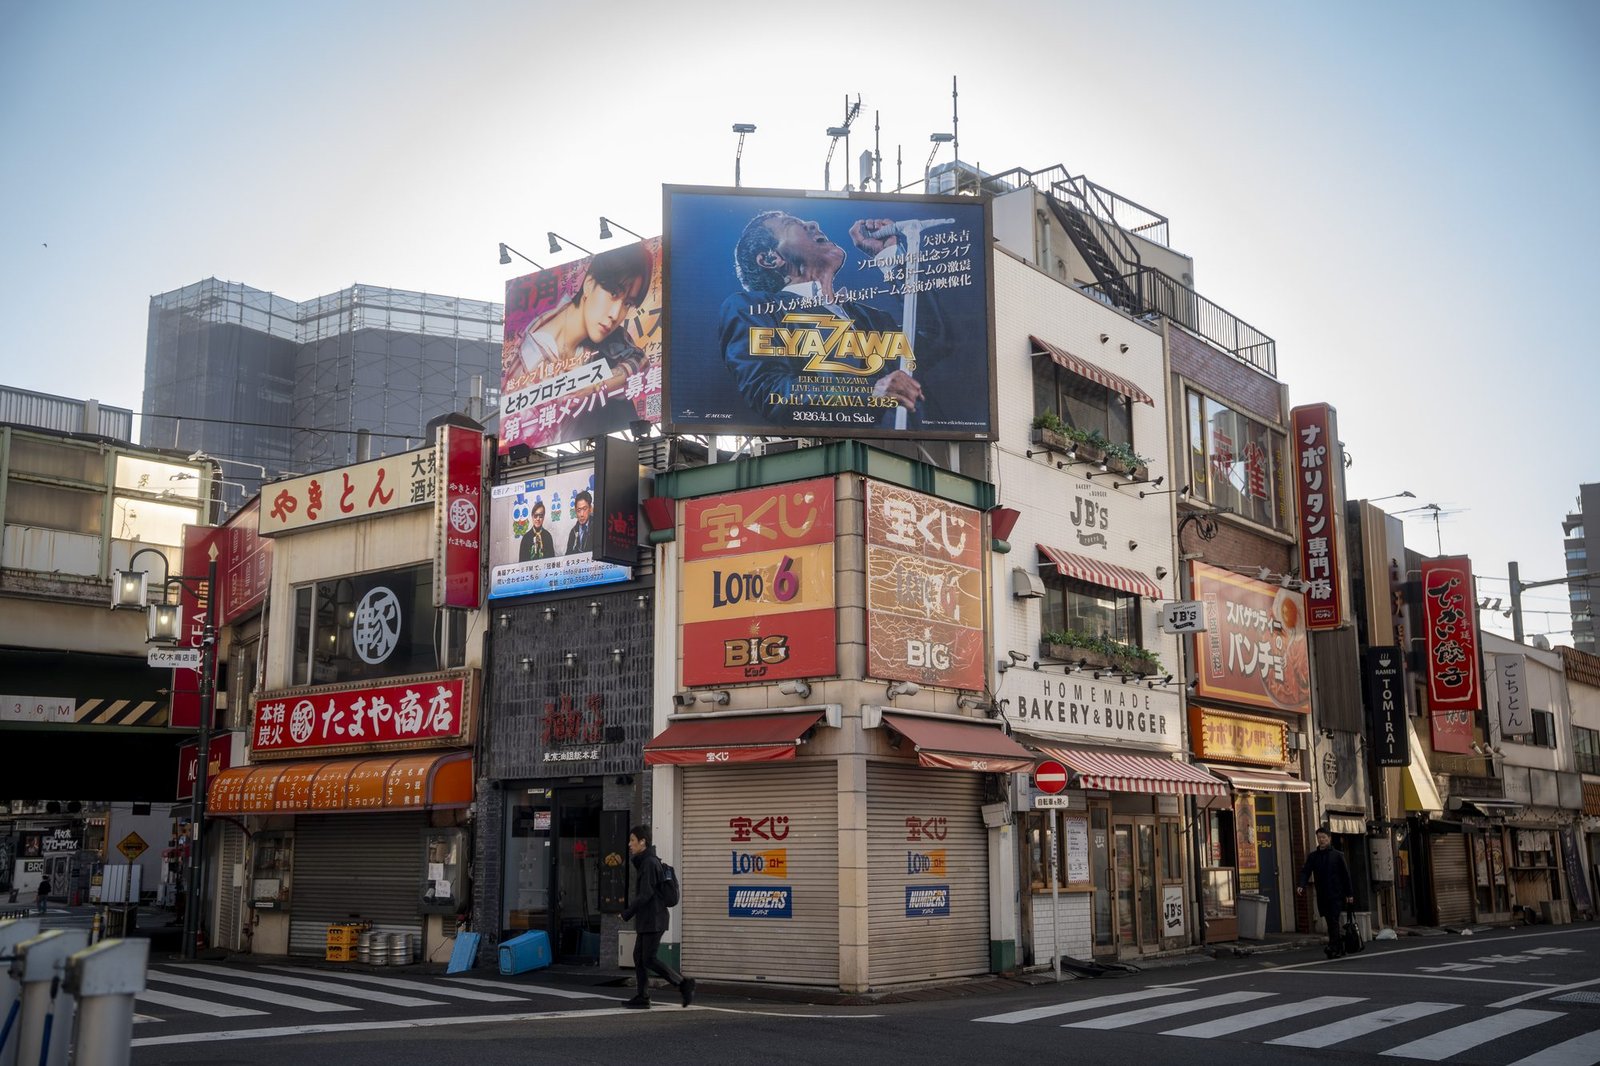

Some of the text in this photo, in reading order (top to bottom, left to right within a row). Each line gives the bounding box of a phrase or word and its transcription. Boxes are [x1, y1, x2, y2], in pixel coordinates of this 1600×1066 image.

[923, 229, 971, 247] 矢沢永吉
[858, 243, 971, 271] ソロ50周年記念ライブ
[883, 260, 971, 282] 蘇るドームの激震
[748, 274, 972, 315] 11万人が熱狂した東京ドーム公演が映像化
[505, 364, 604, 415] とわプロデュース
[799, 376, 868, 385] EIKICHI YAZAWA
[504, 367, 662, 442] 第一弾メンバー募集
[769, 393, 899, 408] Do It! YAZAWA 2025
[793, 411, 875, 423] 2026.4.1 On Sale
[270, 468, 394, 523] やきとん
[449, 482, 480, 496] やきとん
[700, 491, 818, 552] 宝くじ
[1301, 424, 1332, 600] ナポリタン専門店
[883, 497, 966, 558] 宝くじ
[448, 536, 479, 549] たまや商店
[713, 555, 800, 608] LOTO 6
[150, 653, 198, 662] 代々木商店街
[724, 635, 790, 667] BIG
[906, 639, 951, 670] BIG
[1228, 632, 1285, 682] パンチョ
[744, 667, 768, 677] ビッグ
[1043, 679, 1151, 711] HOMEMADE
[1504, 662, 1523, 727] ごちとん
[260, 703, 285, 724] 本格
[322, 686, 453, 738] たまや商店
[1382, 679, 1396, 754] TOMIRAI
[257, 725, 284, 746] 炭火
[543, 750, 600, 762] 東京油組総本店
[706, 752, 729, 762] 宝くじ
[972, 760, 988, 770] 宝くじ
[1038, 797, 1066, 806] 自転車を除く
[54, 829, 72, 839] 代々木
[729, 816, 790, 842] 宝くじ
[905, 816, 948, 842] 宝くじ
[46, 839, 79, 850] ブロードウェイ
[732, 851, 784, 875] LOTO ロト
[908, 851, 930, 875] LOTO
[733, 889, 788, 908] NUMBERS
[908, 889, 947, 908] NUMBERS
